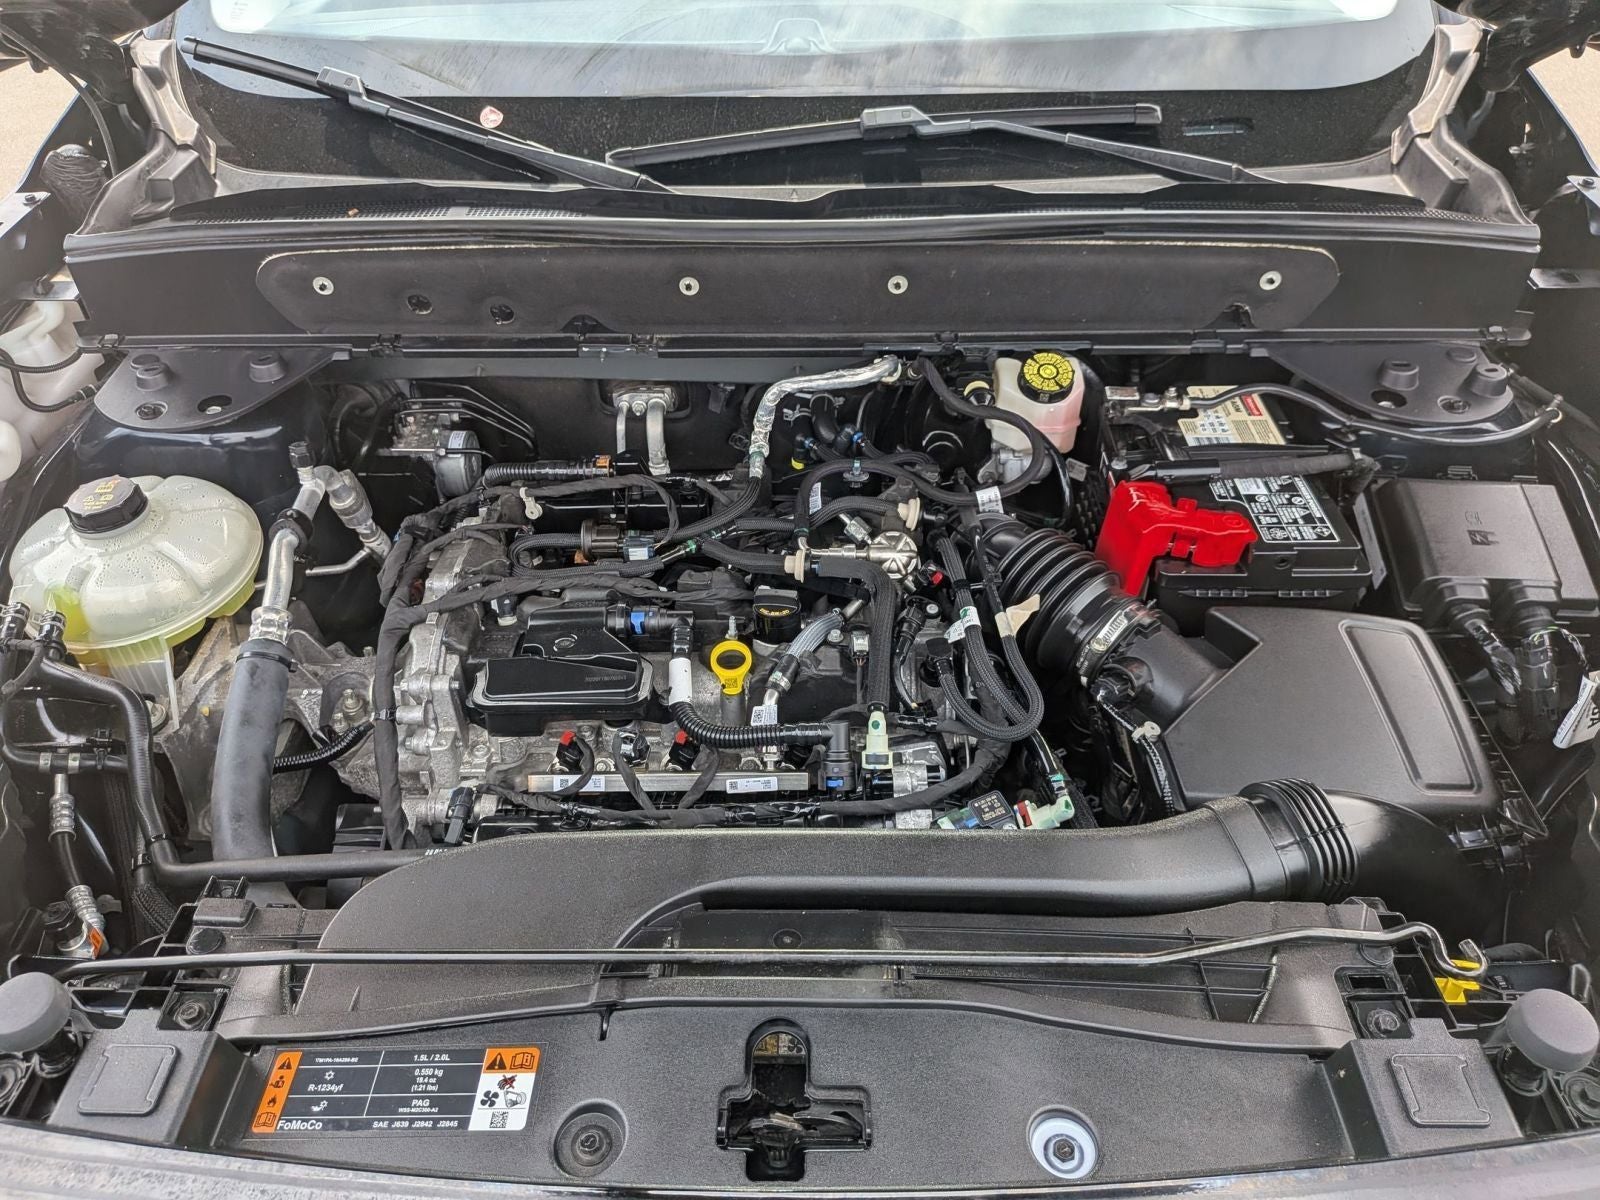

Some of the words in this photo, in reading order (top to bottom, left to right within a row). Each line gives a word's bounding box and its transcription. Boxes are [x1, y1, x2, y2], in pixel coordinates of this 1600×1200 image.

[434, 1053, 450, 1061] 2.0L
[414, 1068, 433, 1076] 0.550
[434, 1067, 444, 1077] kg
[307, 1083, 344, 1093] R-1234yf
[411, 1099, 430, 1107] PAG
[276, 1120, 323, 1130] FoMoCo
[372, 1120, 389, 1128] SAE
[436, 1120, 459, 1128] J2845
